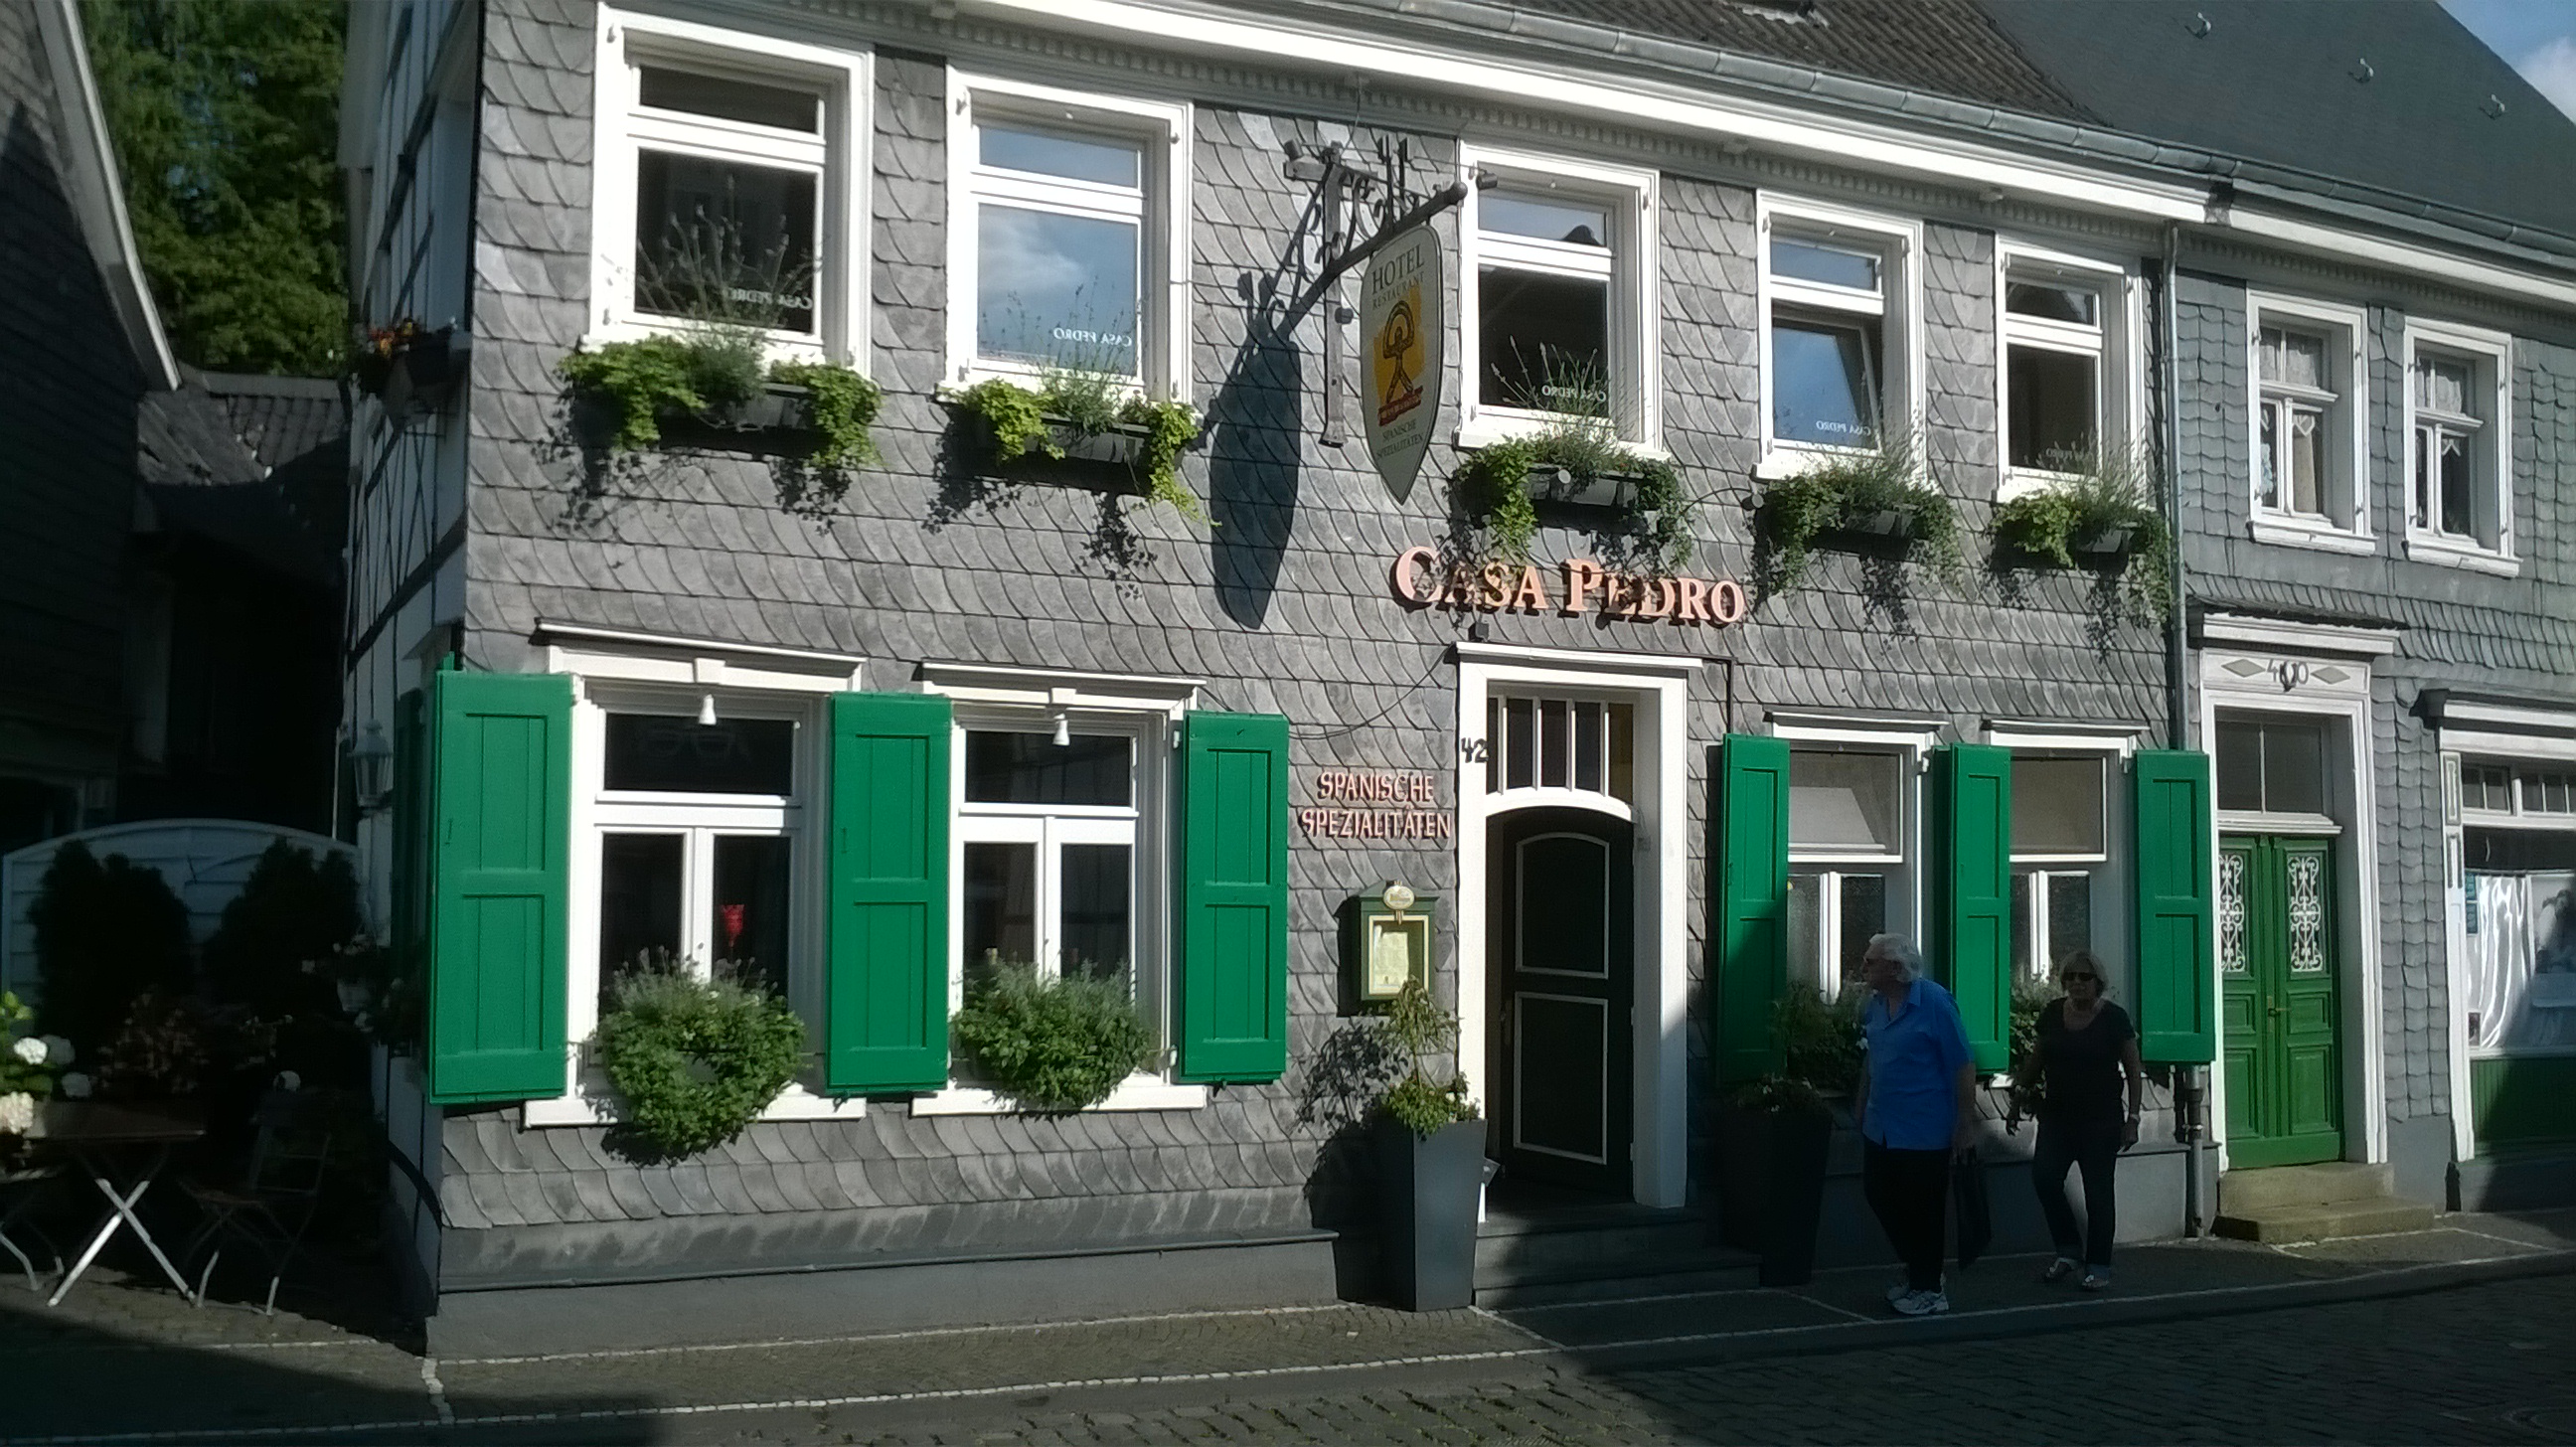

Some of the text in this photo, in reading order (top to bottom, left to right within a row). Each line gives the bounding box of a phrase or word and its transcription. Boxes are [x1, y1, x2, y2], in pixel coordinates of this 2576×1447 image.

[1371, 244, 1424, 294] HOTEL
[1372, 271, 1424, 310] RESTAURANT
[1395, 545, 1745, 624] CASA PEDRO
[1461, 737, 1489, 763] 42
[1319, 771, 1434, 801] SPANISCHE
[1301, 805, 1451, 838] SPEZIALITÄTEN
